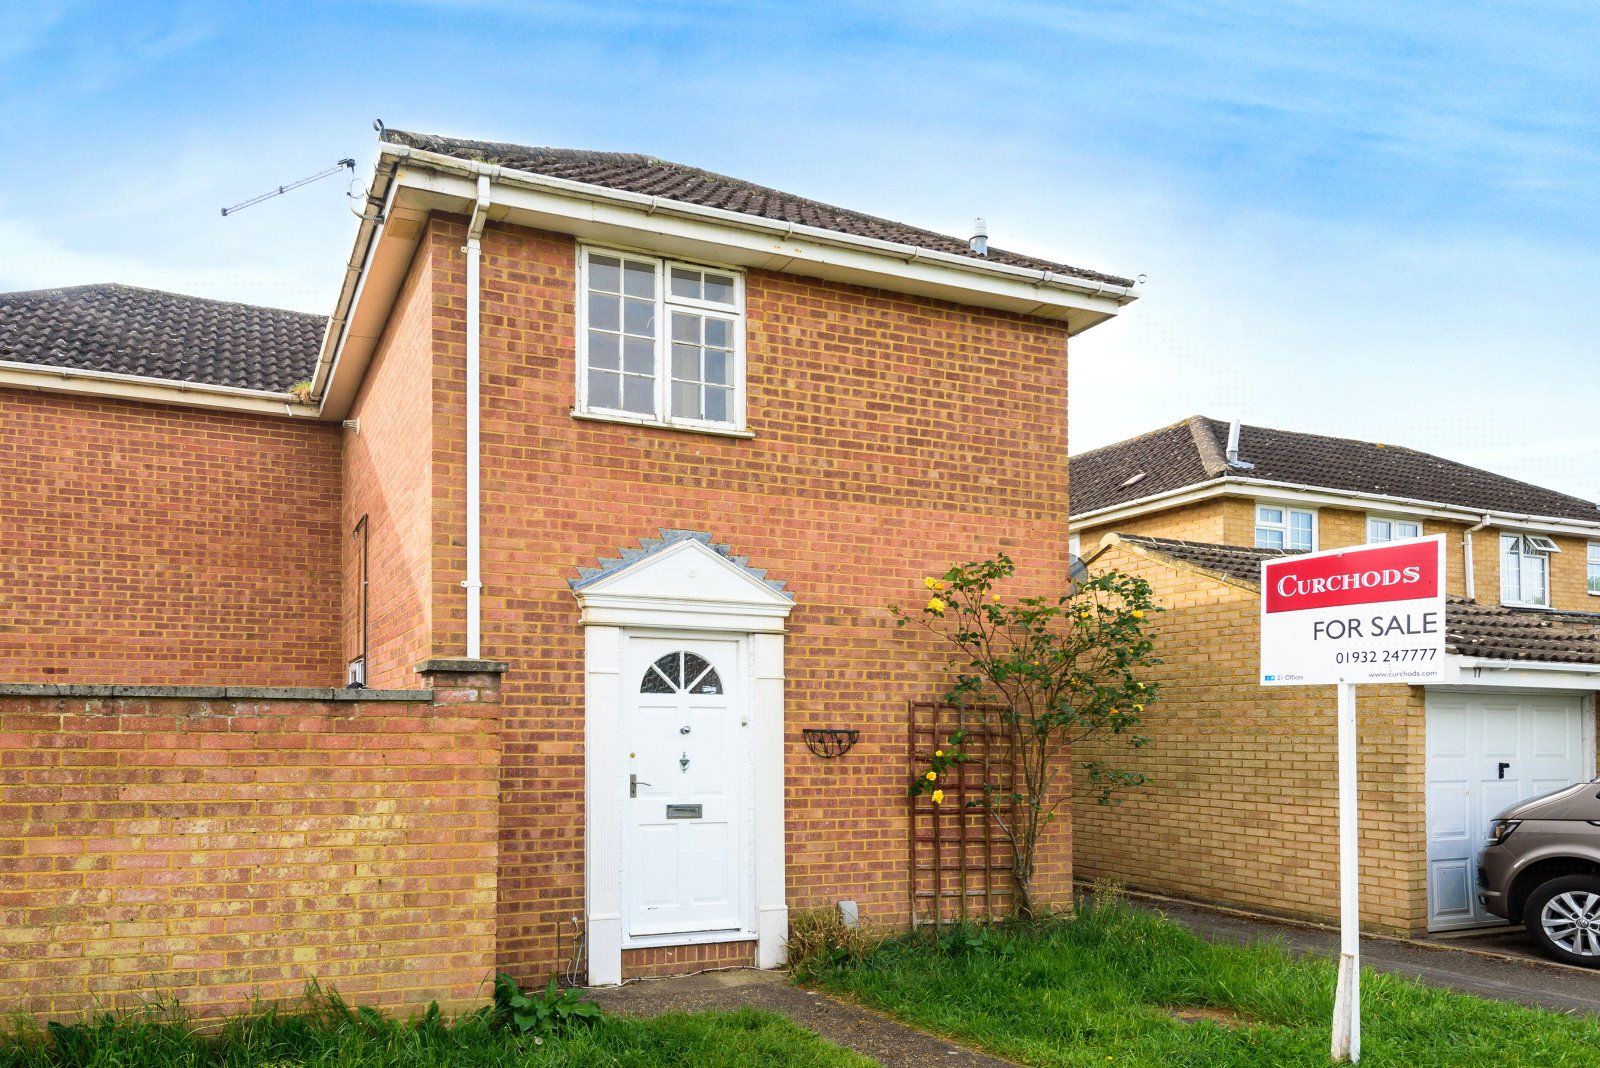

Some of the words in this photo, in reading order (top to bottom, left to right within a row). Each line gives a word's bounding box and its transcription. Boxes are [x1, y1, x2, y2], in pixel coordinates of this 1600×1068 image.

[1277, 566, 1421, 597] CURCHODS
[1313, 618, 1364, 641] FOR
[1371, 612, 1438, 637] SALE
[1336, 650, 1377, 664] 01932
[1383, 648, 1437, 663] 247777
[1368, 670, 1438, 678] www.curchods.com
